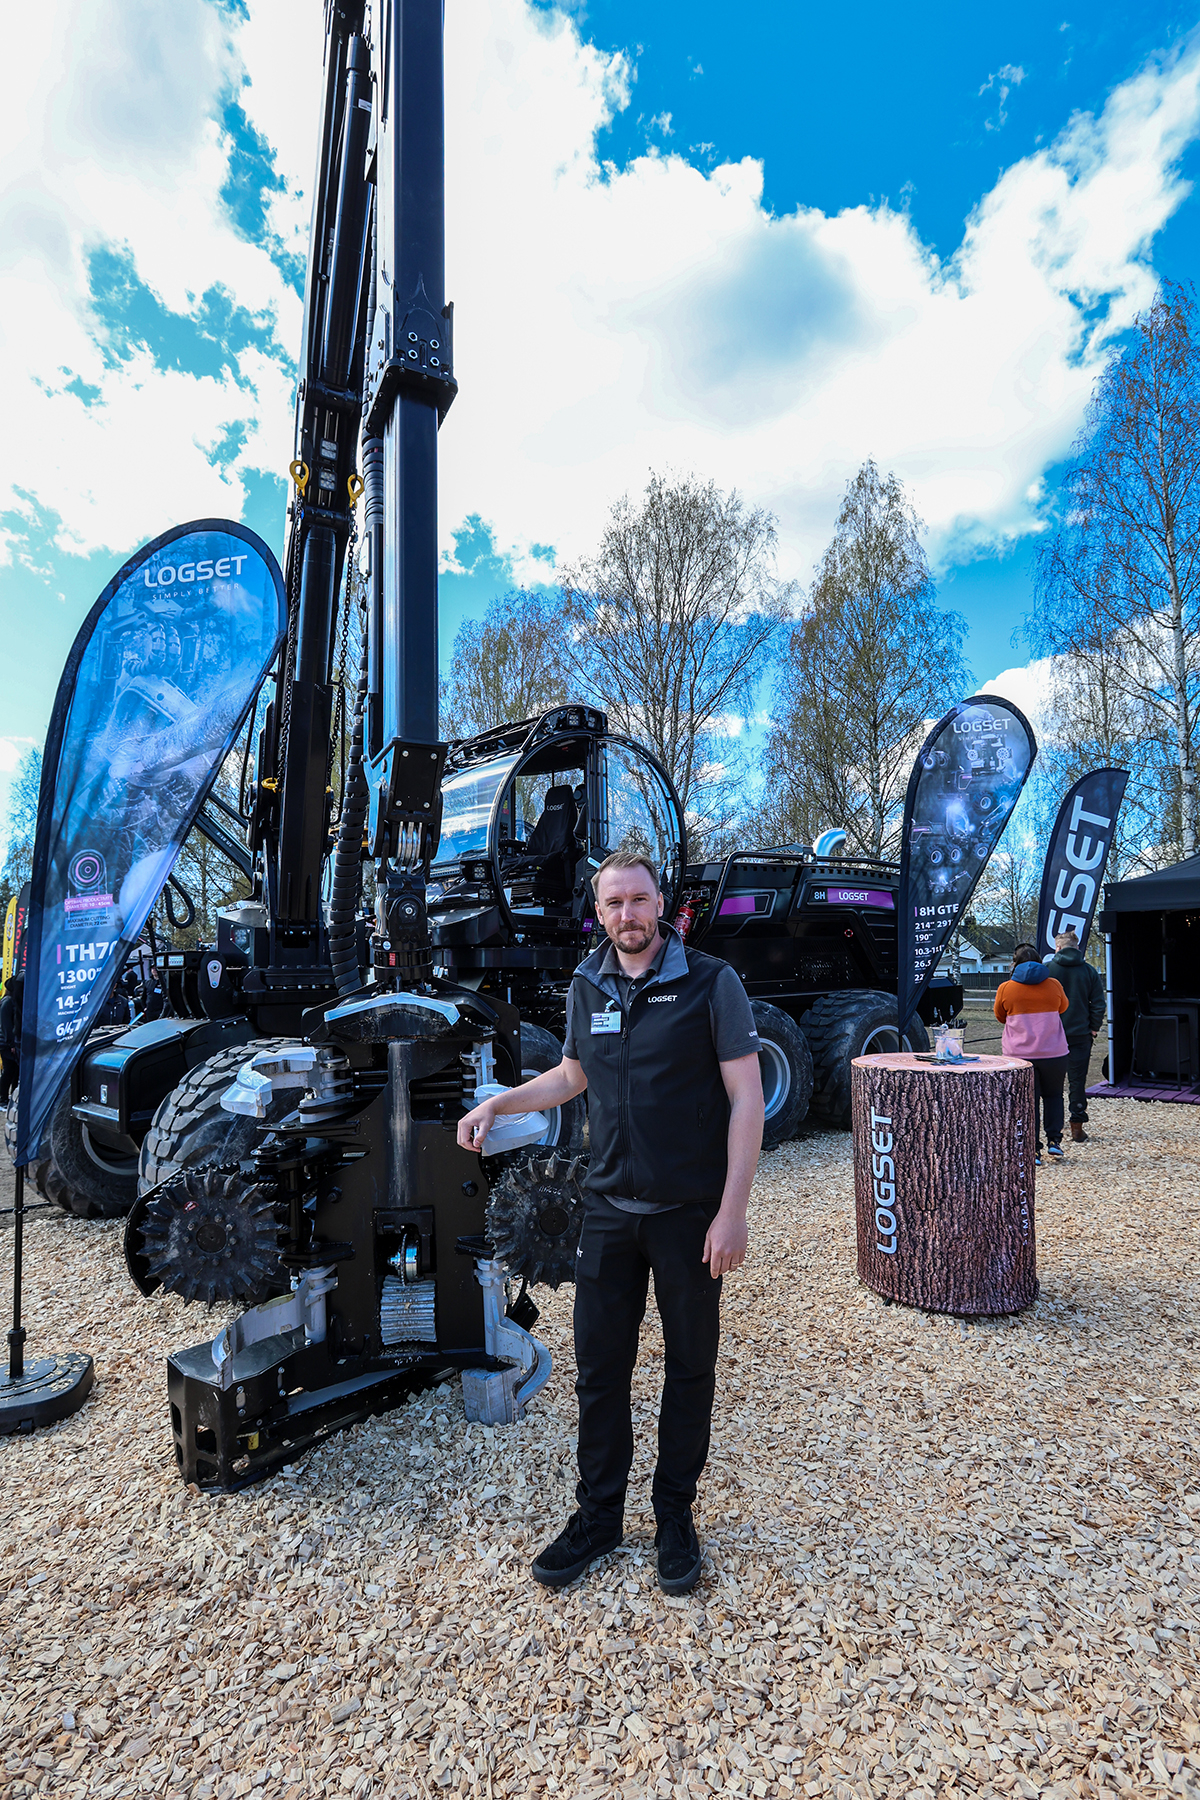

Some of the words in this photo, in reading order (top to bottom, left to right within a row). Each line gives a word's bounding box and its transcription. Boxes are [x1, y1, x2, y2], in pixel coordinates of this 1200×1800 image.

[144, 554, 248, 588] LOGSET
[152, 590, 192, 601] SIMPLY
[198, 583, 240, 595] BETTER
[952, 717, 1012, 734] LOGSET
[1042, 795, 1112, 964] GSET
[814, 891, 826, 900] 8H
[838, 891, 869, 901] LOGSET
[919, 906, 935, 917] 8H
[937, 903, 960, 915] GTE
[647, 994, 678, 1004] LOGSET
[871, 1106, 897, 1254] LOGSET
[1019, 1189, 1028, 1246] SIMPLY
